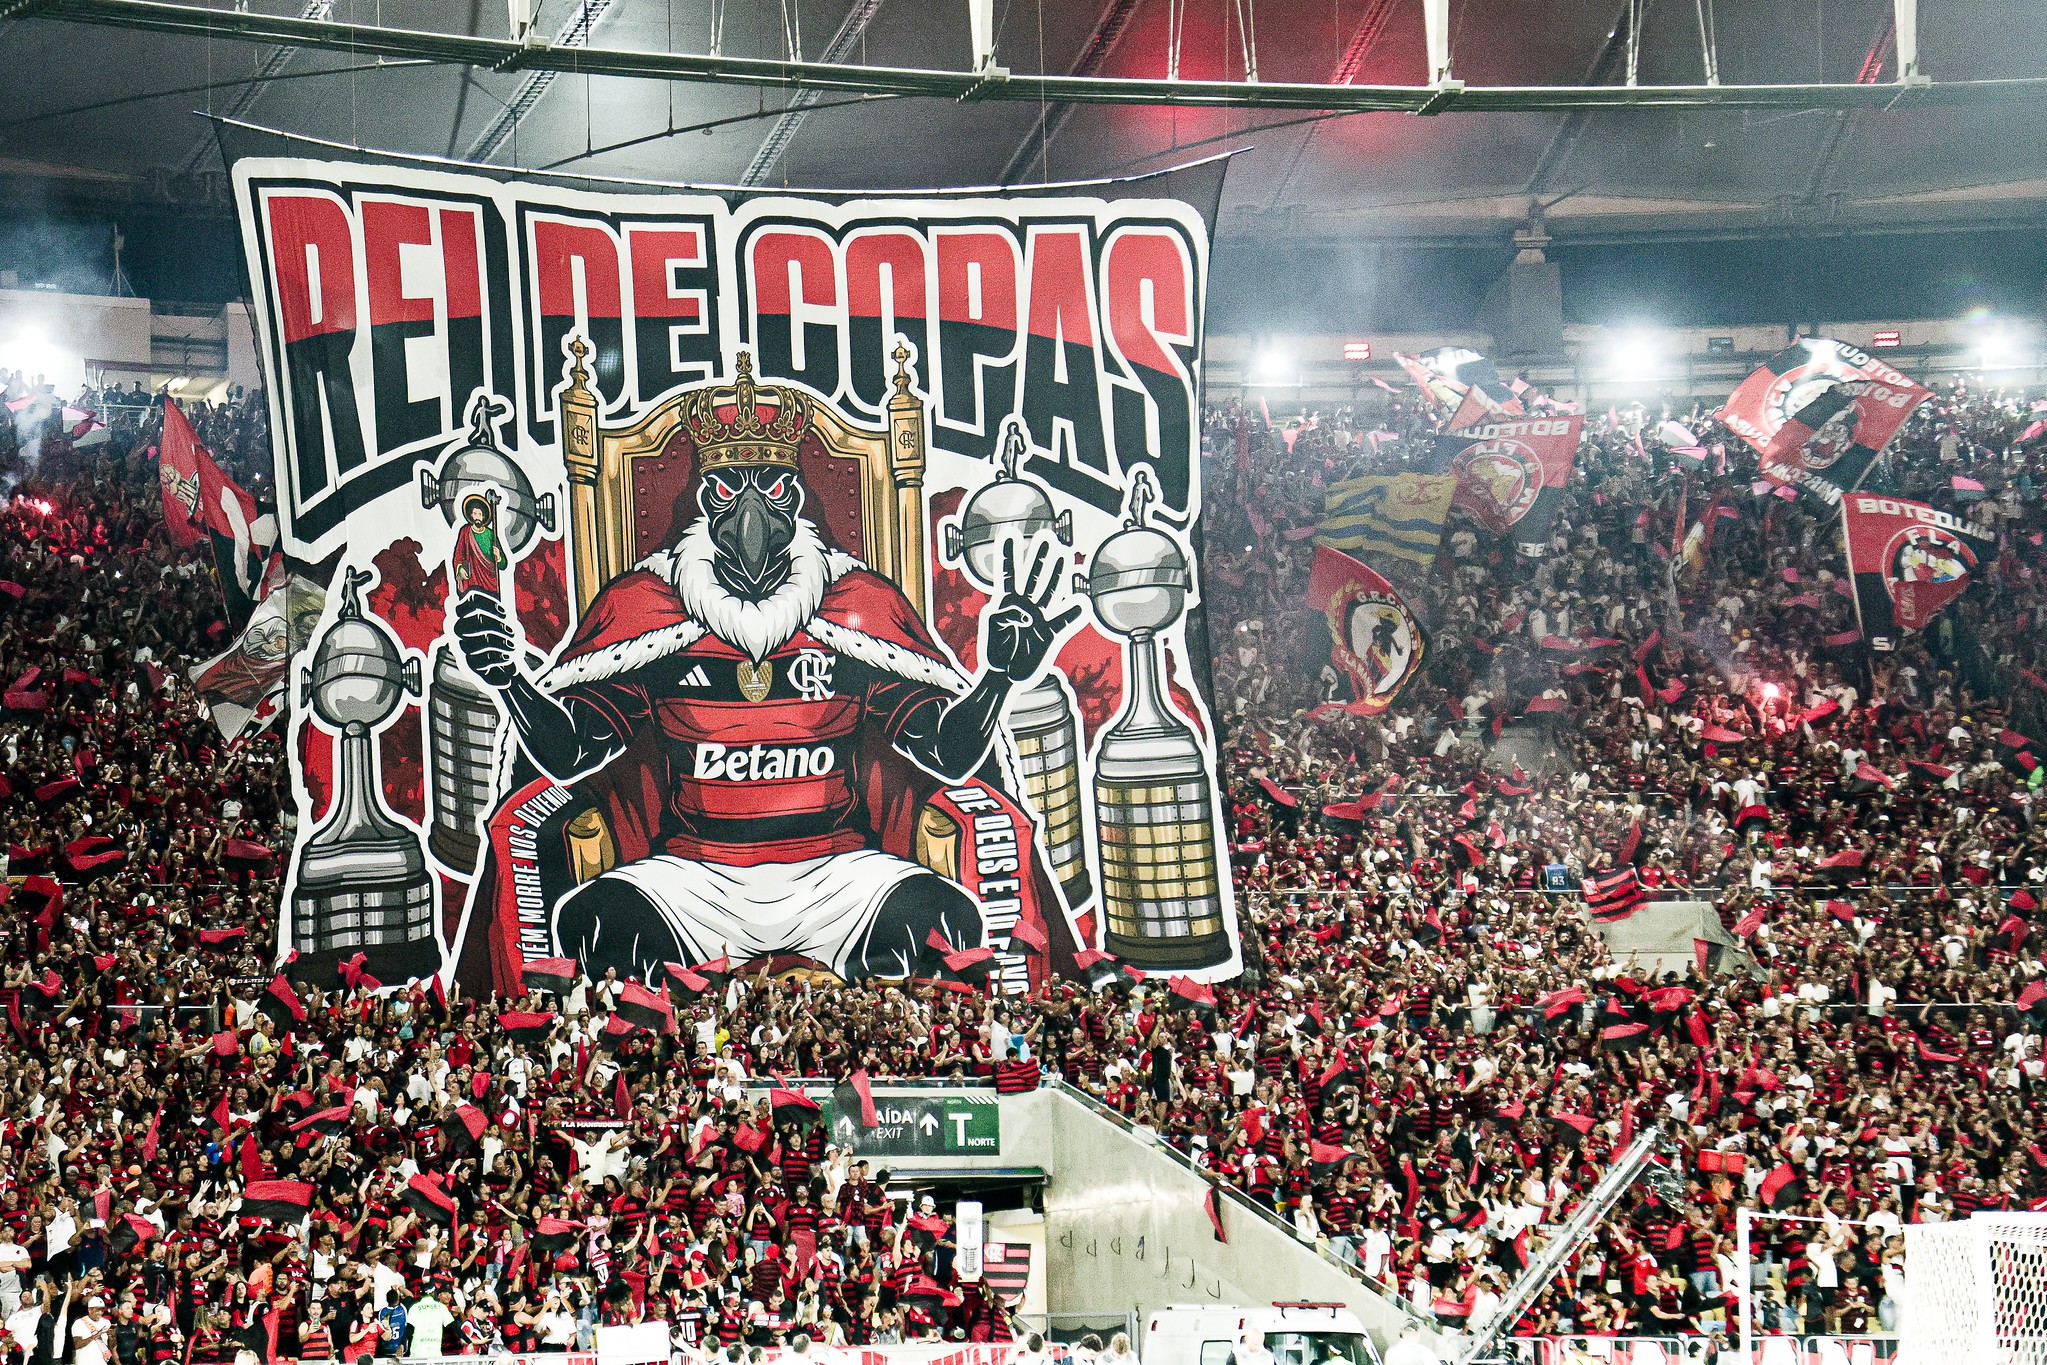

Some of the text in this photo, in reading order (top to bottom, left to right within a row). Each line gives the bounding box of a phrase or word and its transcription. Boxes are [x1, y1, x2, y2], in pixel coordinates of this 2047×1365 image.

[262, 188, 1195, 520] REI DE COPAS
[693, 743, 835, 782] Betano
[511, 784, 574, 829] DEVENDO
[943, 786, 1003, 814] DE
[508, 823, 539, 861] NOS
[974, 814, 1020, 875] DEUS
[512, 862, 547, 926] MORRE
[979, 879, 1021, 896] E
[876, 1109, 914, 1125] AÍDA
[876, 1127, 903, 1139] EXIT
[948, 1112, 996, 1147] T NORTE
